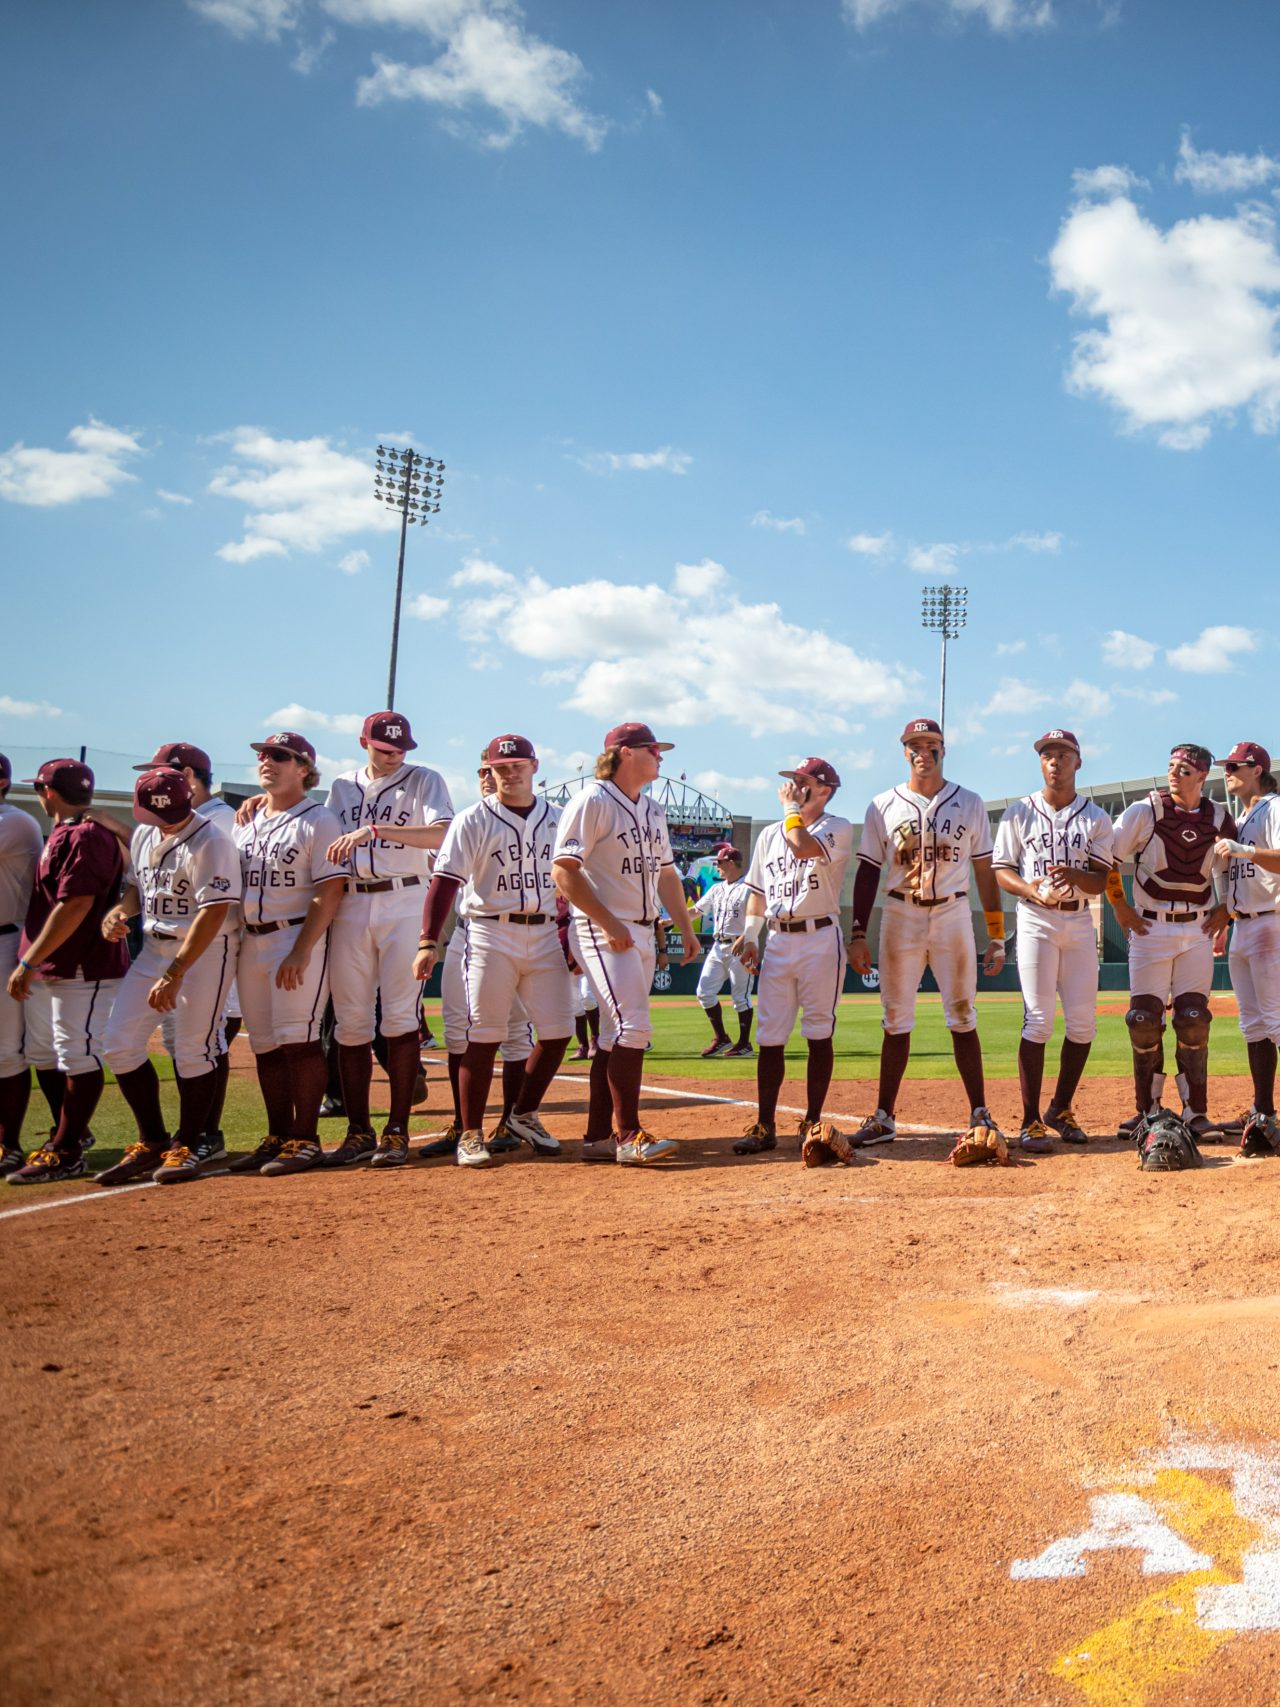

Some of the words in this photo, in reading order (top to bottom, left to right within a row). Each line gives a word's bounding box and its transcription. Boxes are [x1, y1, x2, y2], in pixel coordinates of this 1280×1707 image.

[340, 803, 410, 826] TEXAS
[894, 817, 966, 841] TEXAS
[491, 841, 551, 867] TEXA
[1026, 831, 1092, 854] TEXAS
[497, 872, 556, 892] AGGIE
